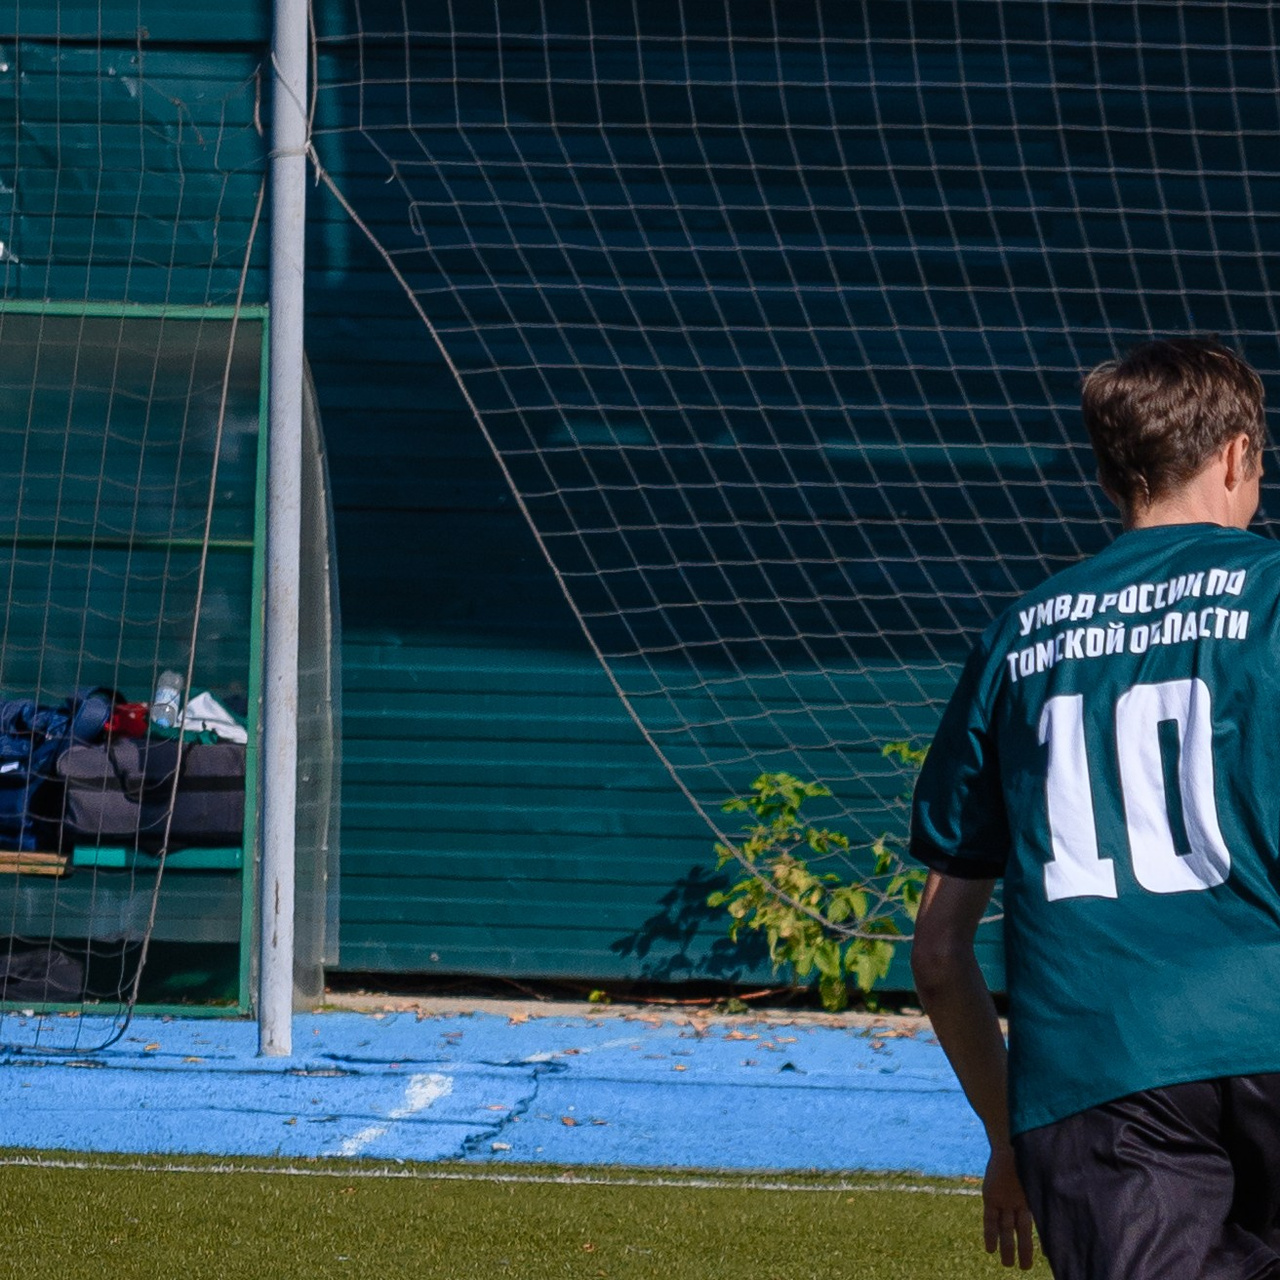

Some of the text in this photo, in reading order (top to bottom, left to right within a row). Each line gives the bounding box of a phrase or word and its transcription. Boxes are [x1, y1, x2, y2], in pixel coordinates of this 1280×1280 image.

[1018, 568, 1248, 637] УМВД РОССИИ ПО
[1006, 607, 1250, 683] ТОМСКОЙ ОБЛАСТИ
[1037, 677, 1232, 902] 10
